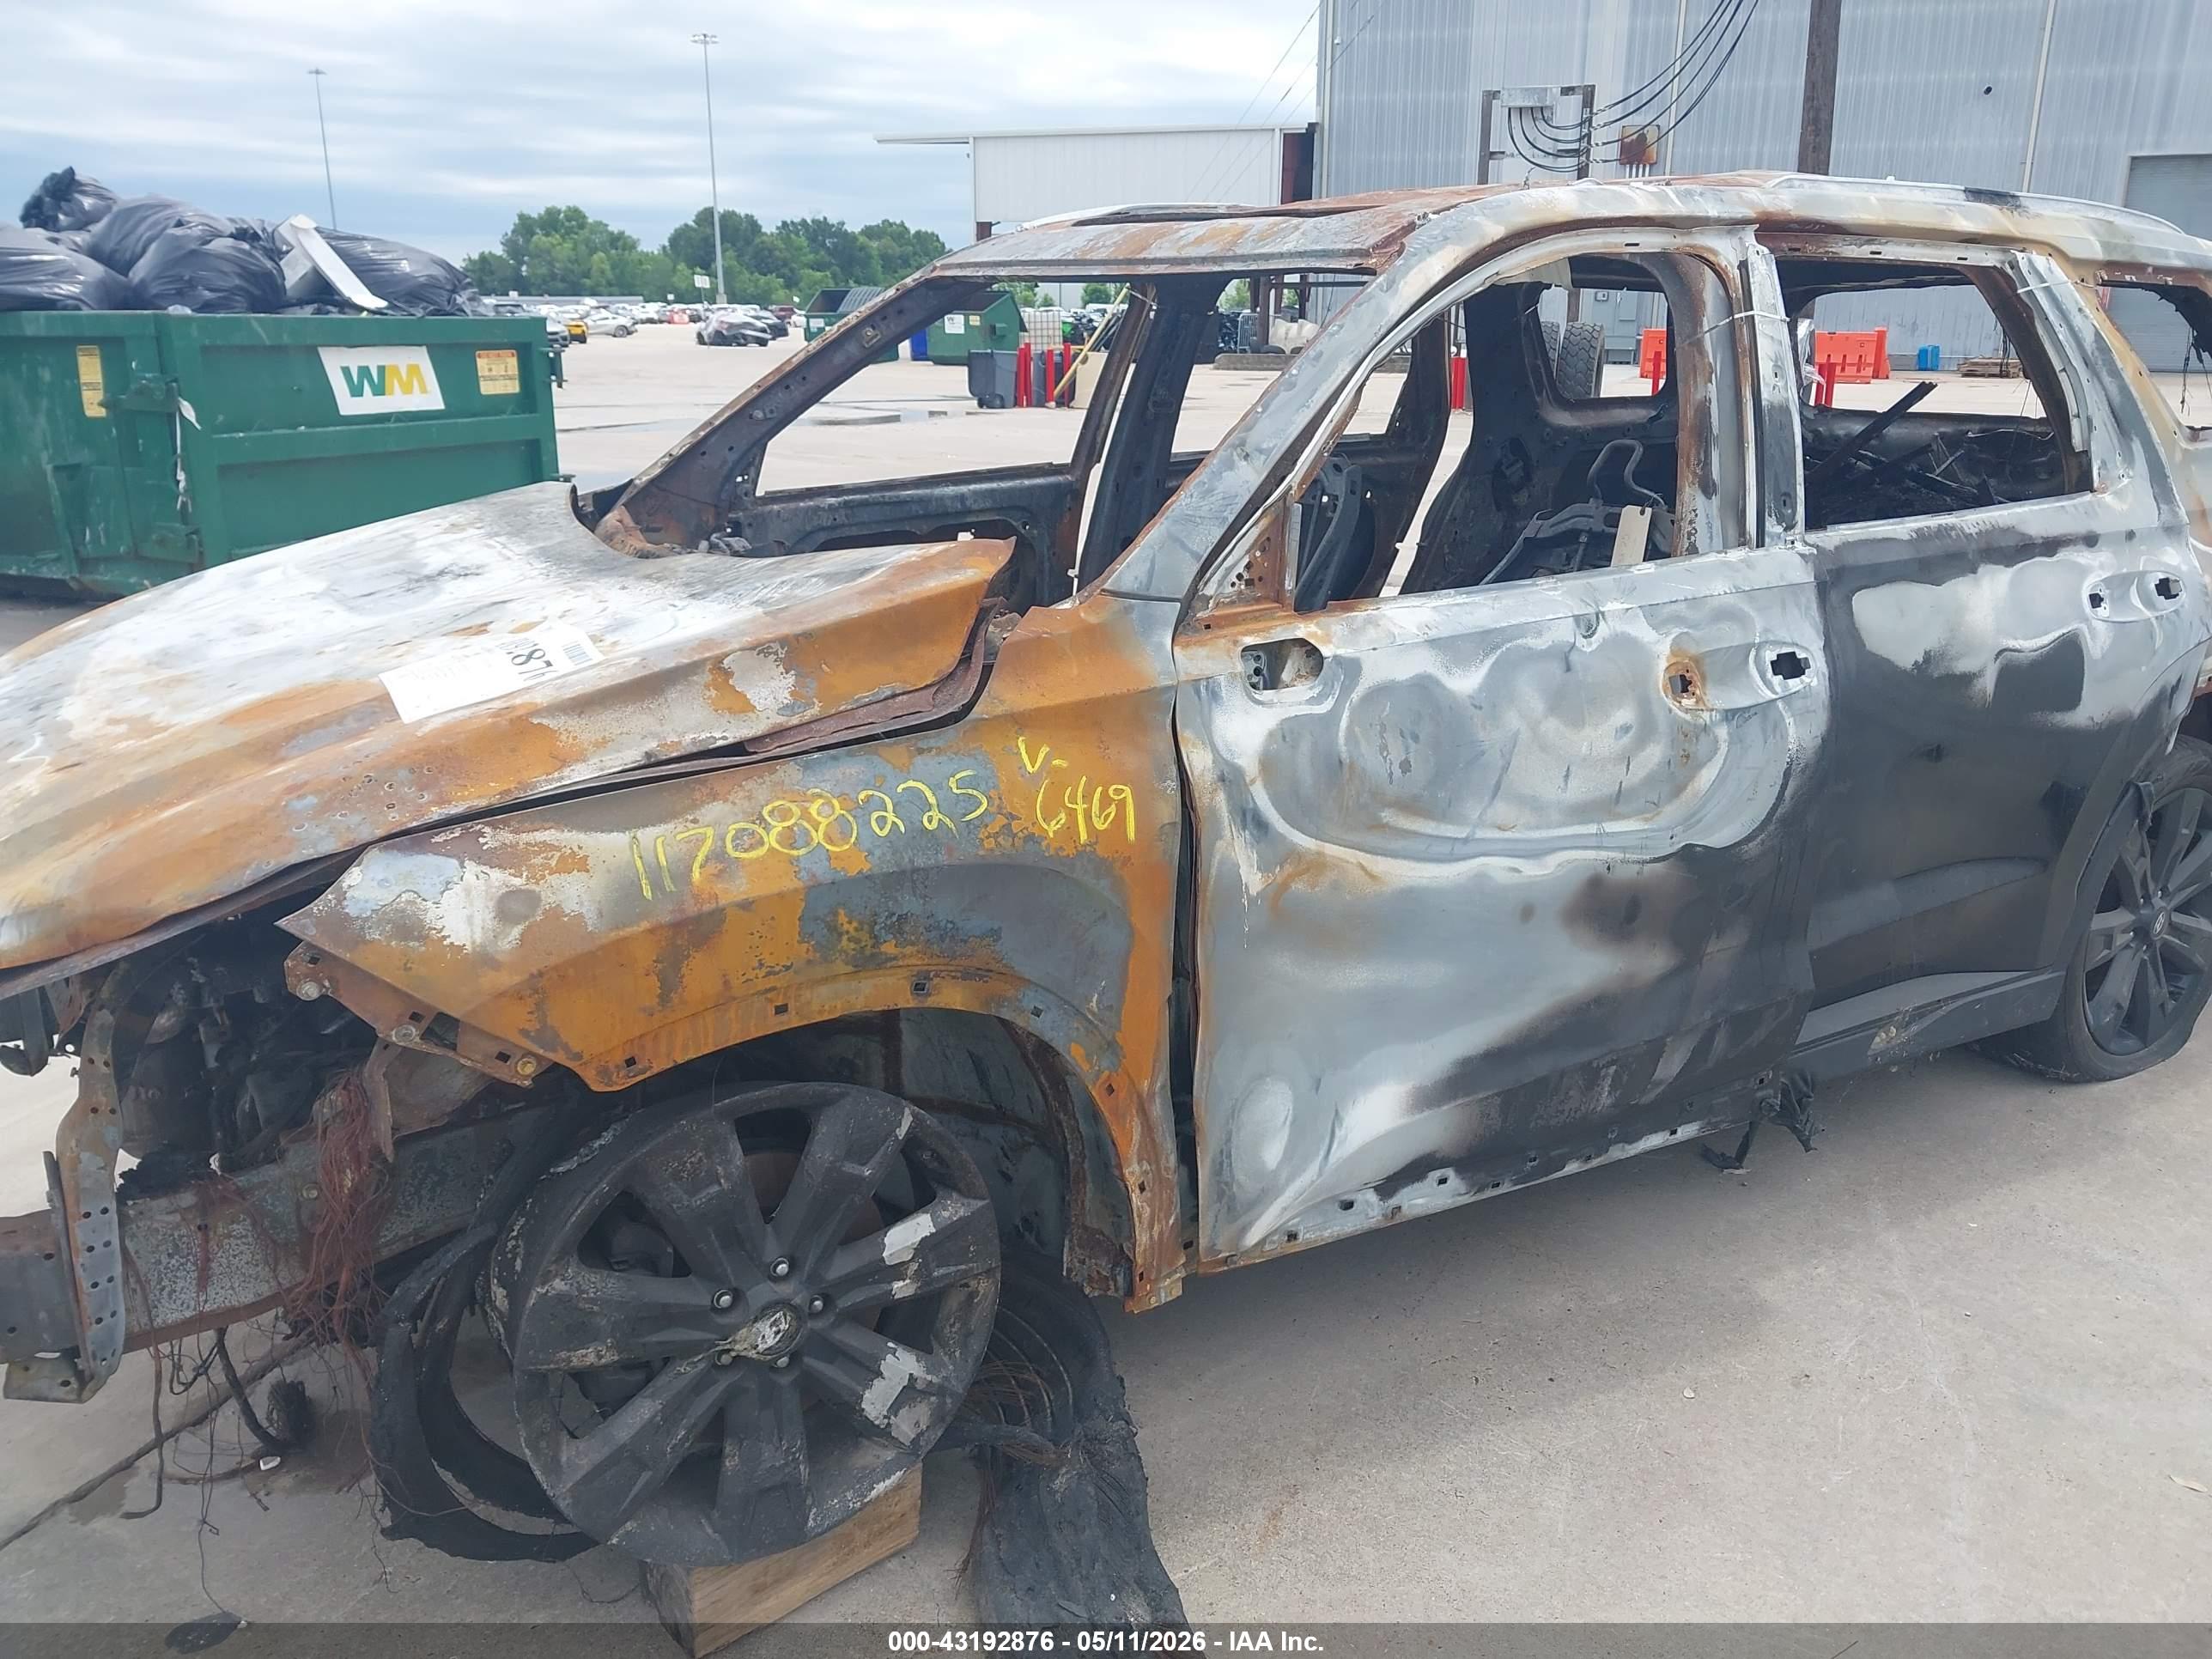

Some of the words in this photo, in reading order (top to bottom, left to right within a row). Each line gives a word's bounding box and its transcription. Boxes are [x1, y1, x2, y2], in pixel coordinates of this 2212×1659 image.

[340, 363, 428, 398] WM
[632, 769, 989, 900] 117088225
[1036, 775, 1135, 845] 6469
